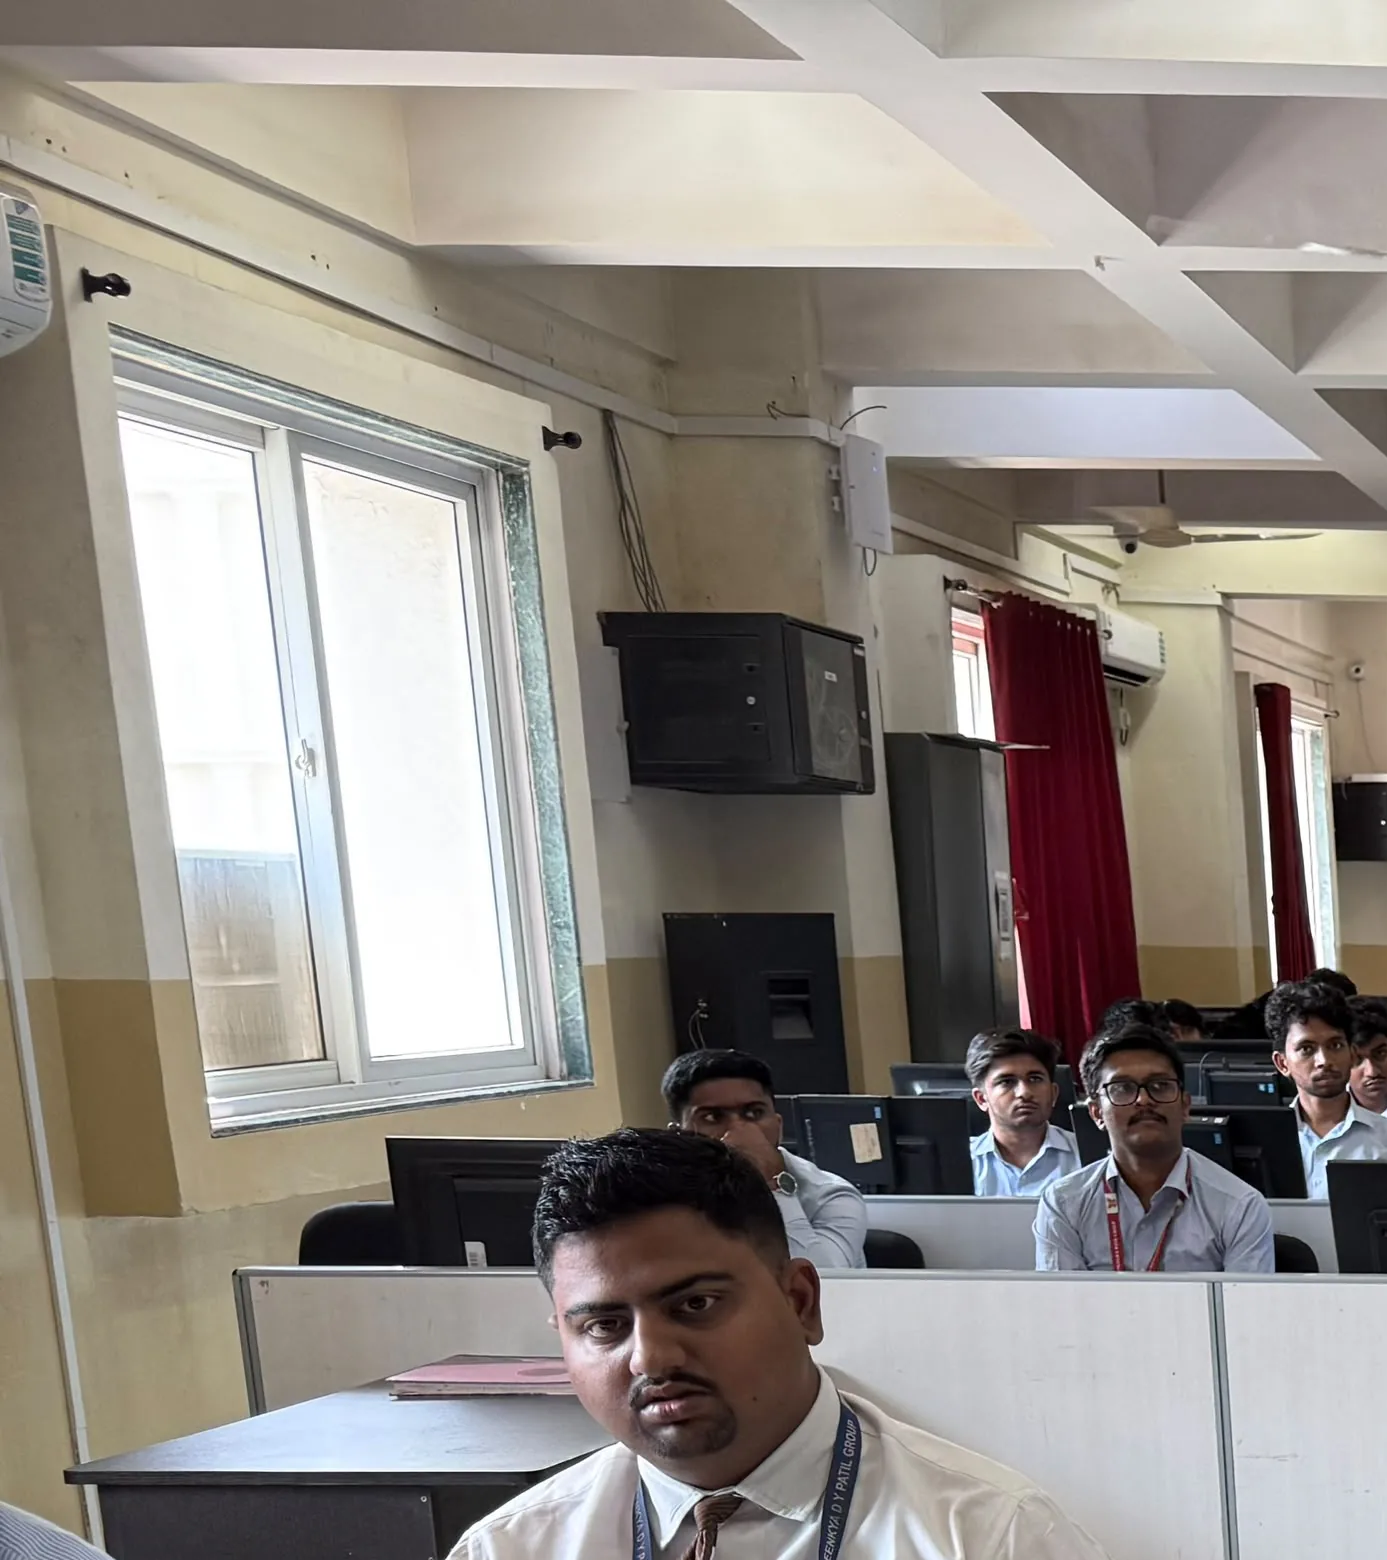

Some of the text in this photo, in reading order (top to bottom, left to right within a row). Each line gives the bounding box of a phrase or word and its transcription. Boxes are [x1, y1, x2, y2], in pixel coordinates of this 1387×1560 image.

[842, 1419, 857, 1458] GROUP
[836, 1460, 853, 1492] PATIL
[833, 1492, 845, 1501] Y
[831, 1504, 842, 1514] D
